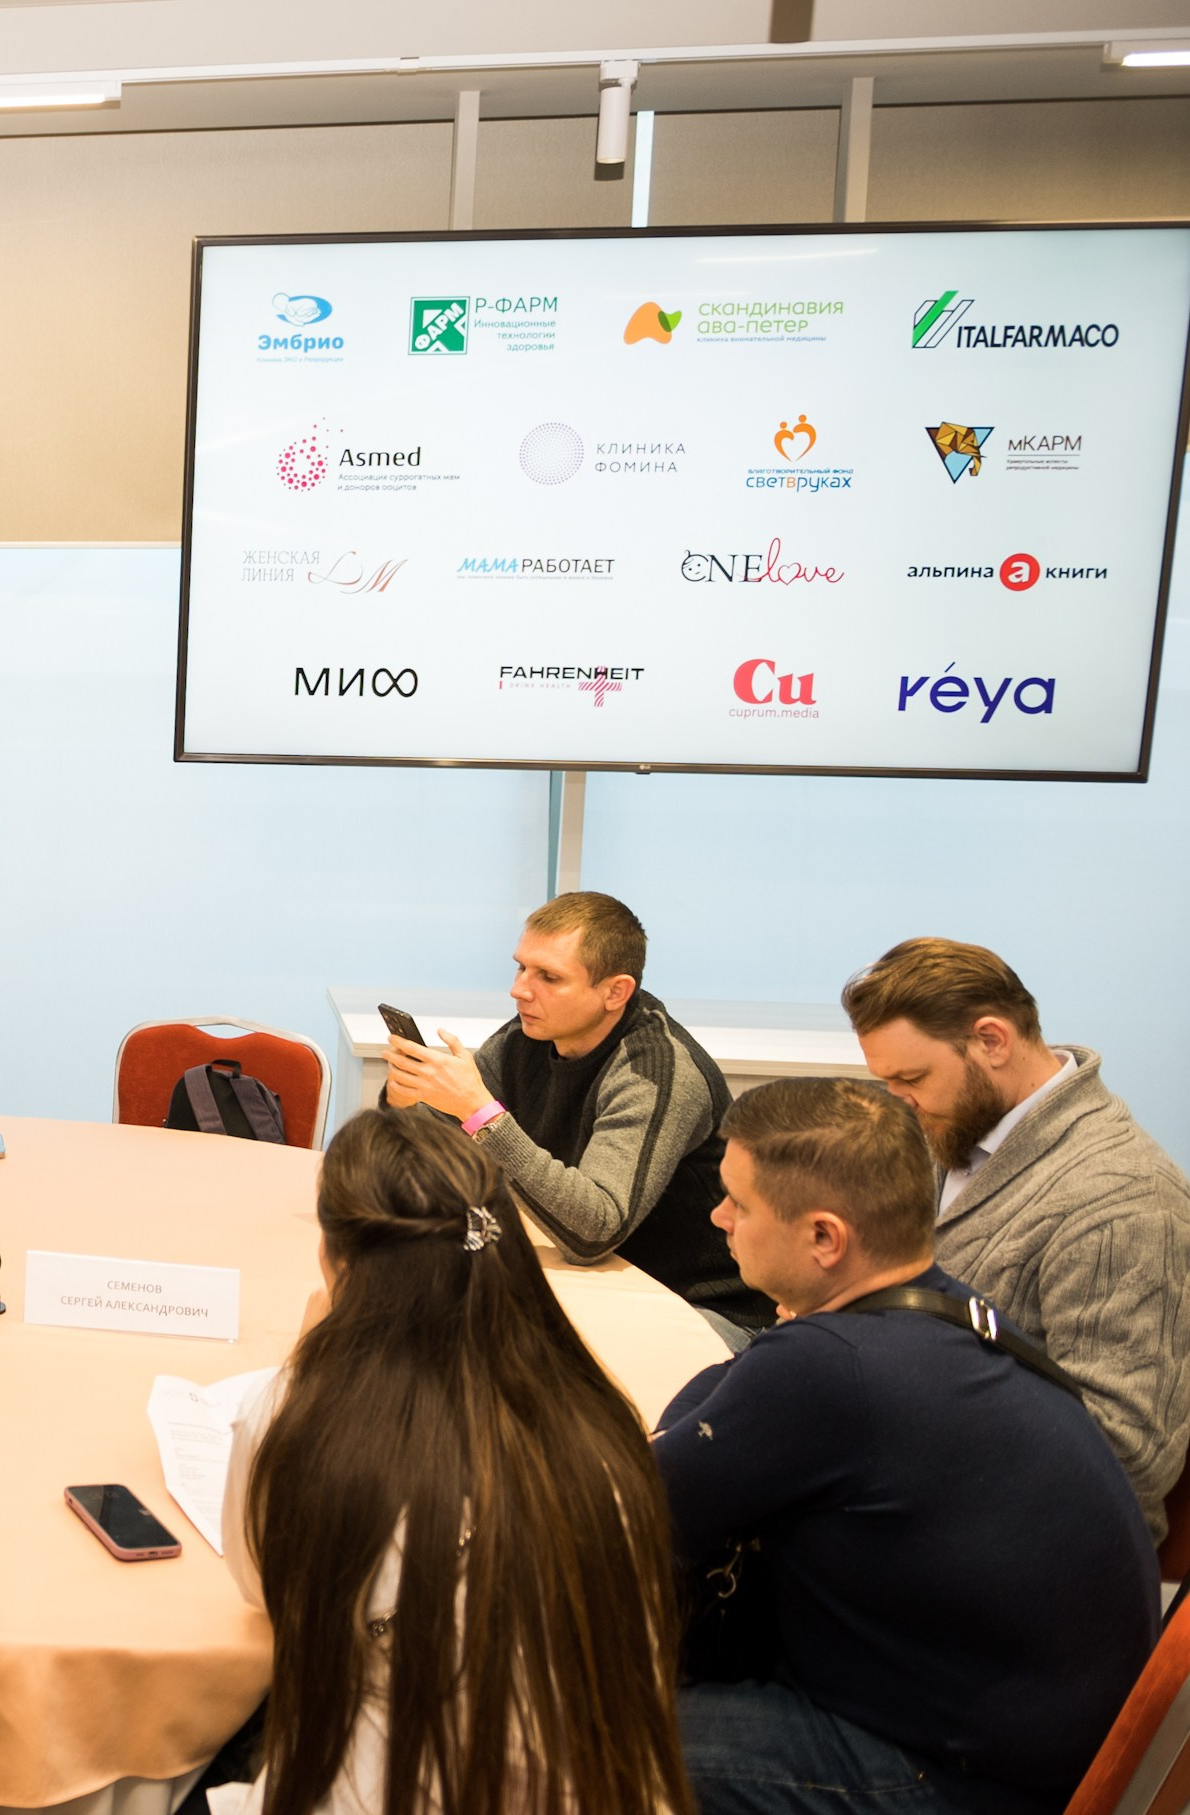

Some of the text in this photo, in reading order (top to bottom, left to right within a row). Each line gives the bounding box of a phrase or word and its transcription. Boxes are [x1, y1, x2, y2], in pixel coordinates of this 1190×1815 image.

[474, 296, 557, 314] Р-ФАРМ
[473, 318, 556, 329] Инновационные
[497, 331, 555, 340] технологии
[954, 322, 1119, 349] ITALFARMACO
[257, 333, 344, 354] Эмбрио
[506, 343, 554, 353] здоровья
[596, 442, 685, 455] КЛИНИКА
[1007, 435, 1082, 452] мКАРМ
[339, 446, 420, 467] Asmed
[594, 461, 677, 473] ФОМИНА
[337, 473, 387, 482] Ассоциация
[343, 484, 380, 493] доноров
[381, 484, 418, 493] ооцитов
[241, 550, 320, 565] ЖЕНСКАЯ
[456, 557, 615, 574] МАМА РАБОТАЕТ
[906, 566, 994, 579] альпина
[1045, 567, 1107, 580] книги
[241, 567, 294, 582] ЛИНИЯ
[499, 665, 645, 680] FAHRENHEIT
[732, 658, 817, 706] Cu
[897, 661, 1056, 724] réya
[728, 706, 819, 720] cuprum.media
[106, 1280, 162, 1295] СЕМЕНОВ
[60, 1295, 208, 1319] СЕРГЕЙ АЛЕКСАНДРОВИЧ
